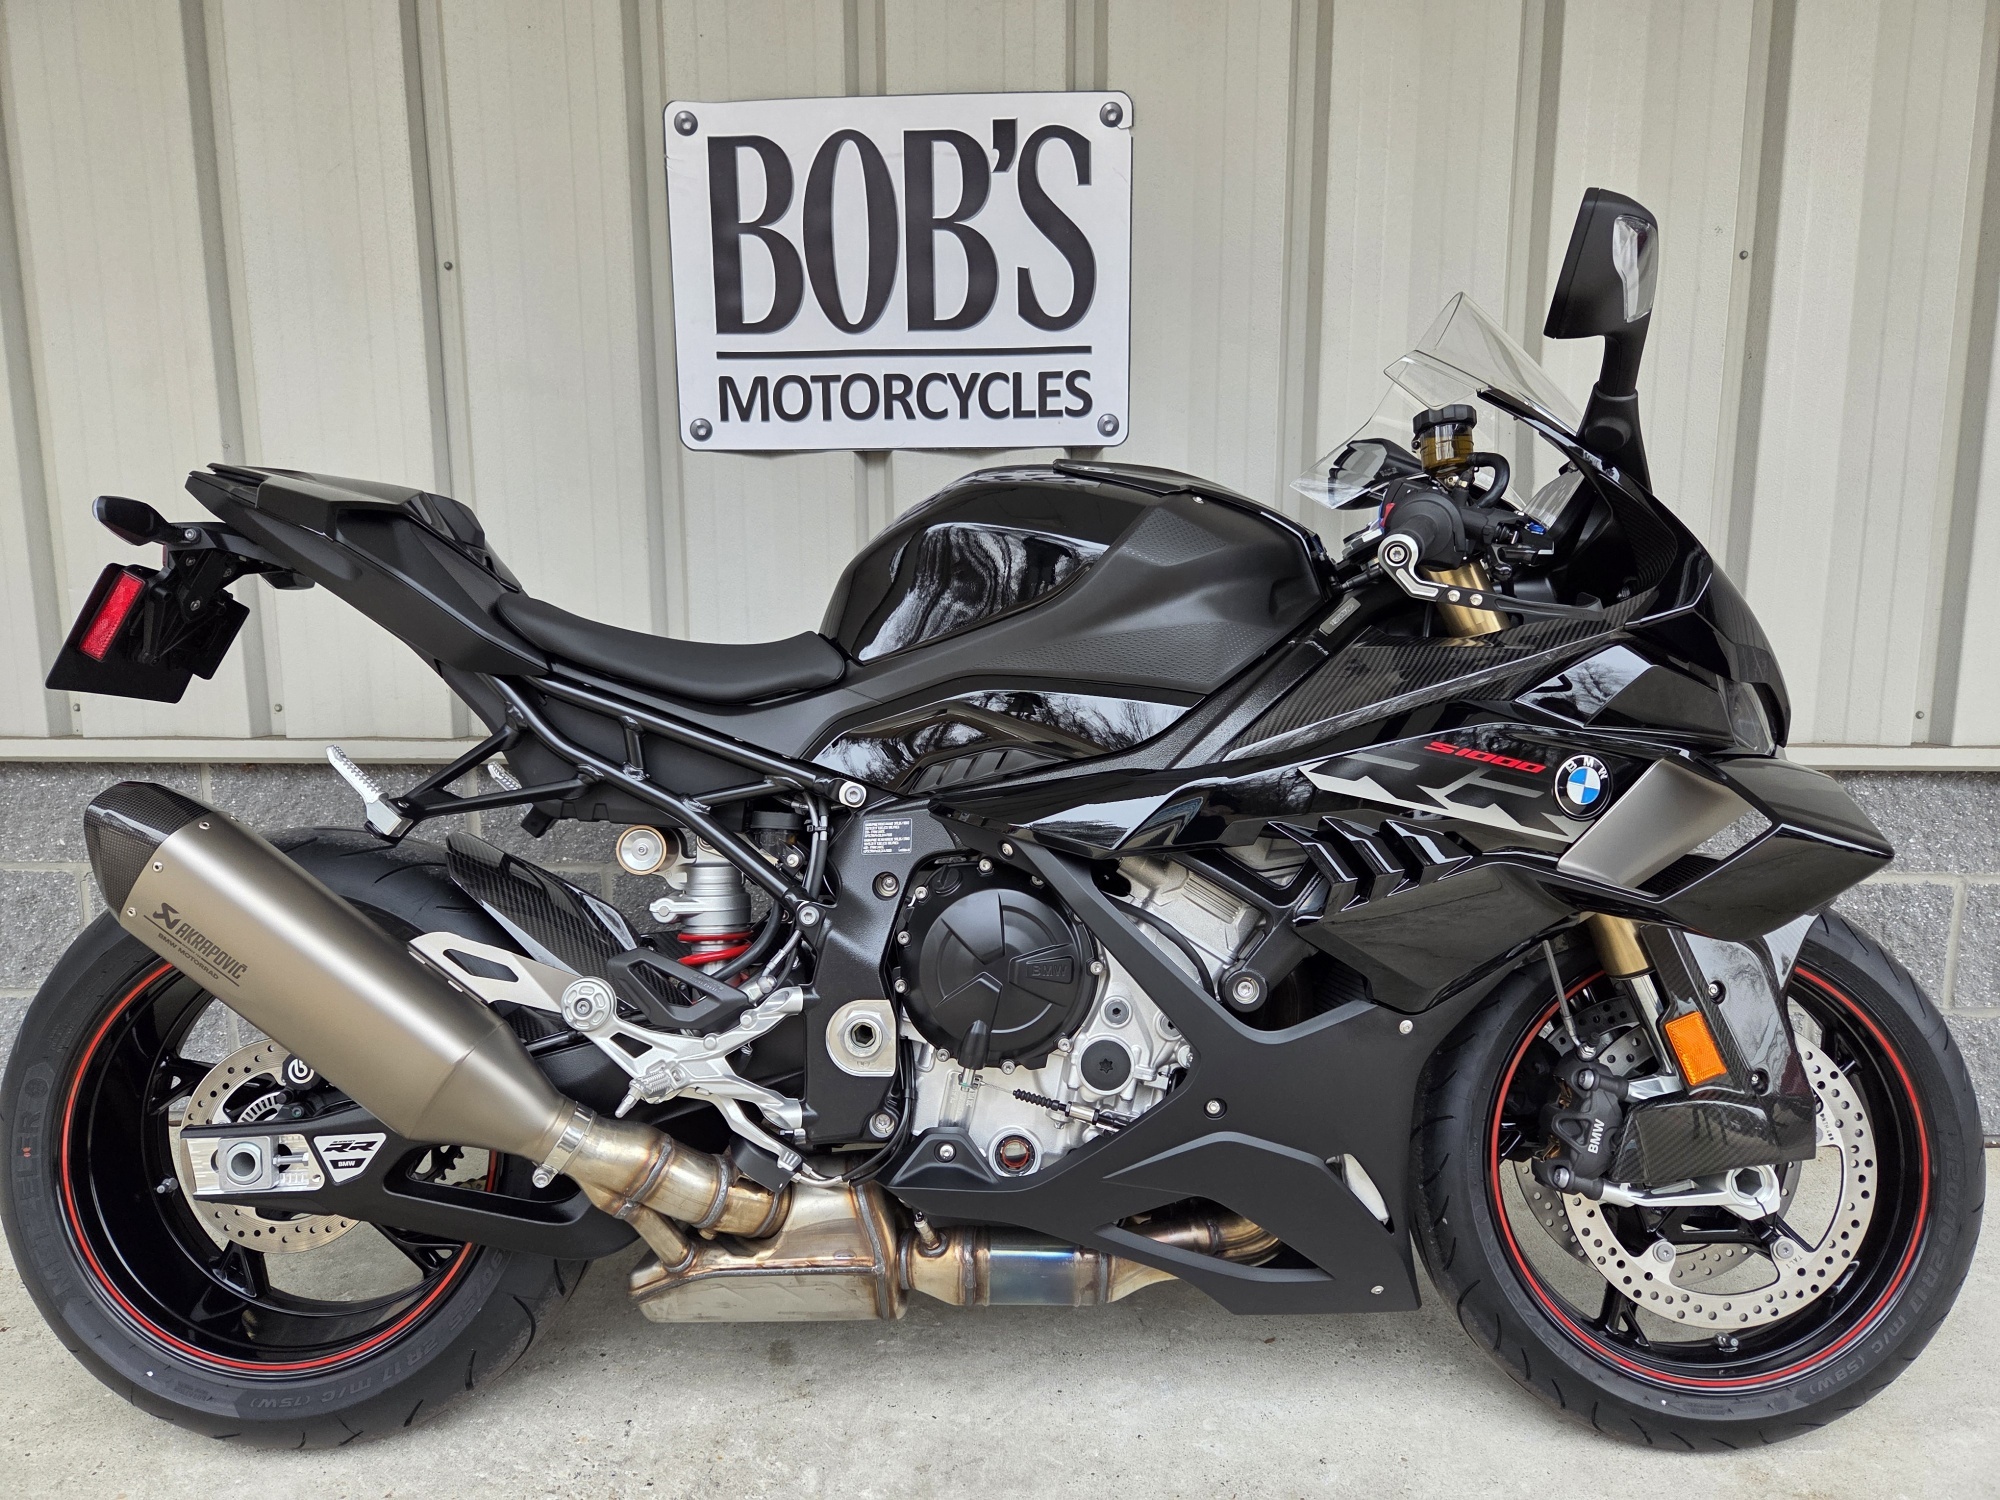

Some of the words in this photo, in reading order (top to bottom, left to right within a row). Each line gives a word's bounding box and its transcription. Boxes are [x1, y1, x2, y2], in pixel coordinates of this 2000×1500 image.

[707, 118, 1096, 335] BOB'S
[717, 369, 1093, 422] MOTORCYCLES
[1424, 741, 1547, 774] S1000
[1565, 757, 1608, 780] BMW
[158, 932, 177, 949] BMW
[178, 947, 219, 980] MOTORRAD
[1031, 965, 1067, 977] BMW
[323, 1141, 378, 1152] RR
[1588, 1118, 1605, 1154] BMW
